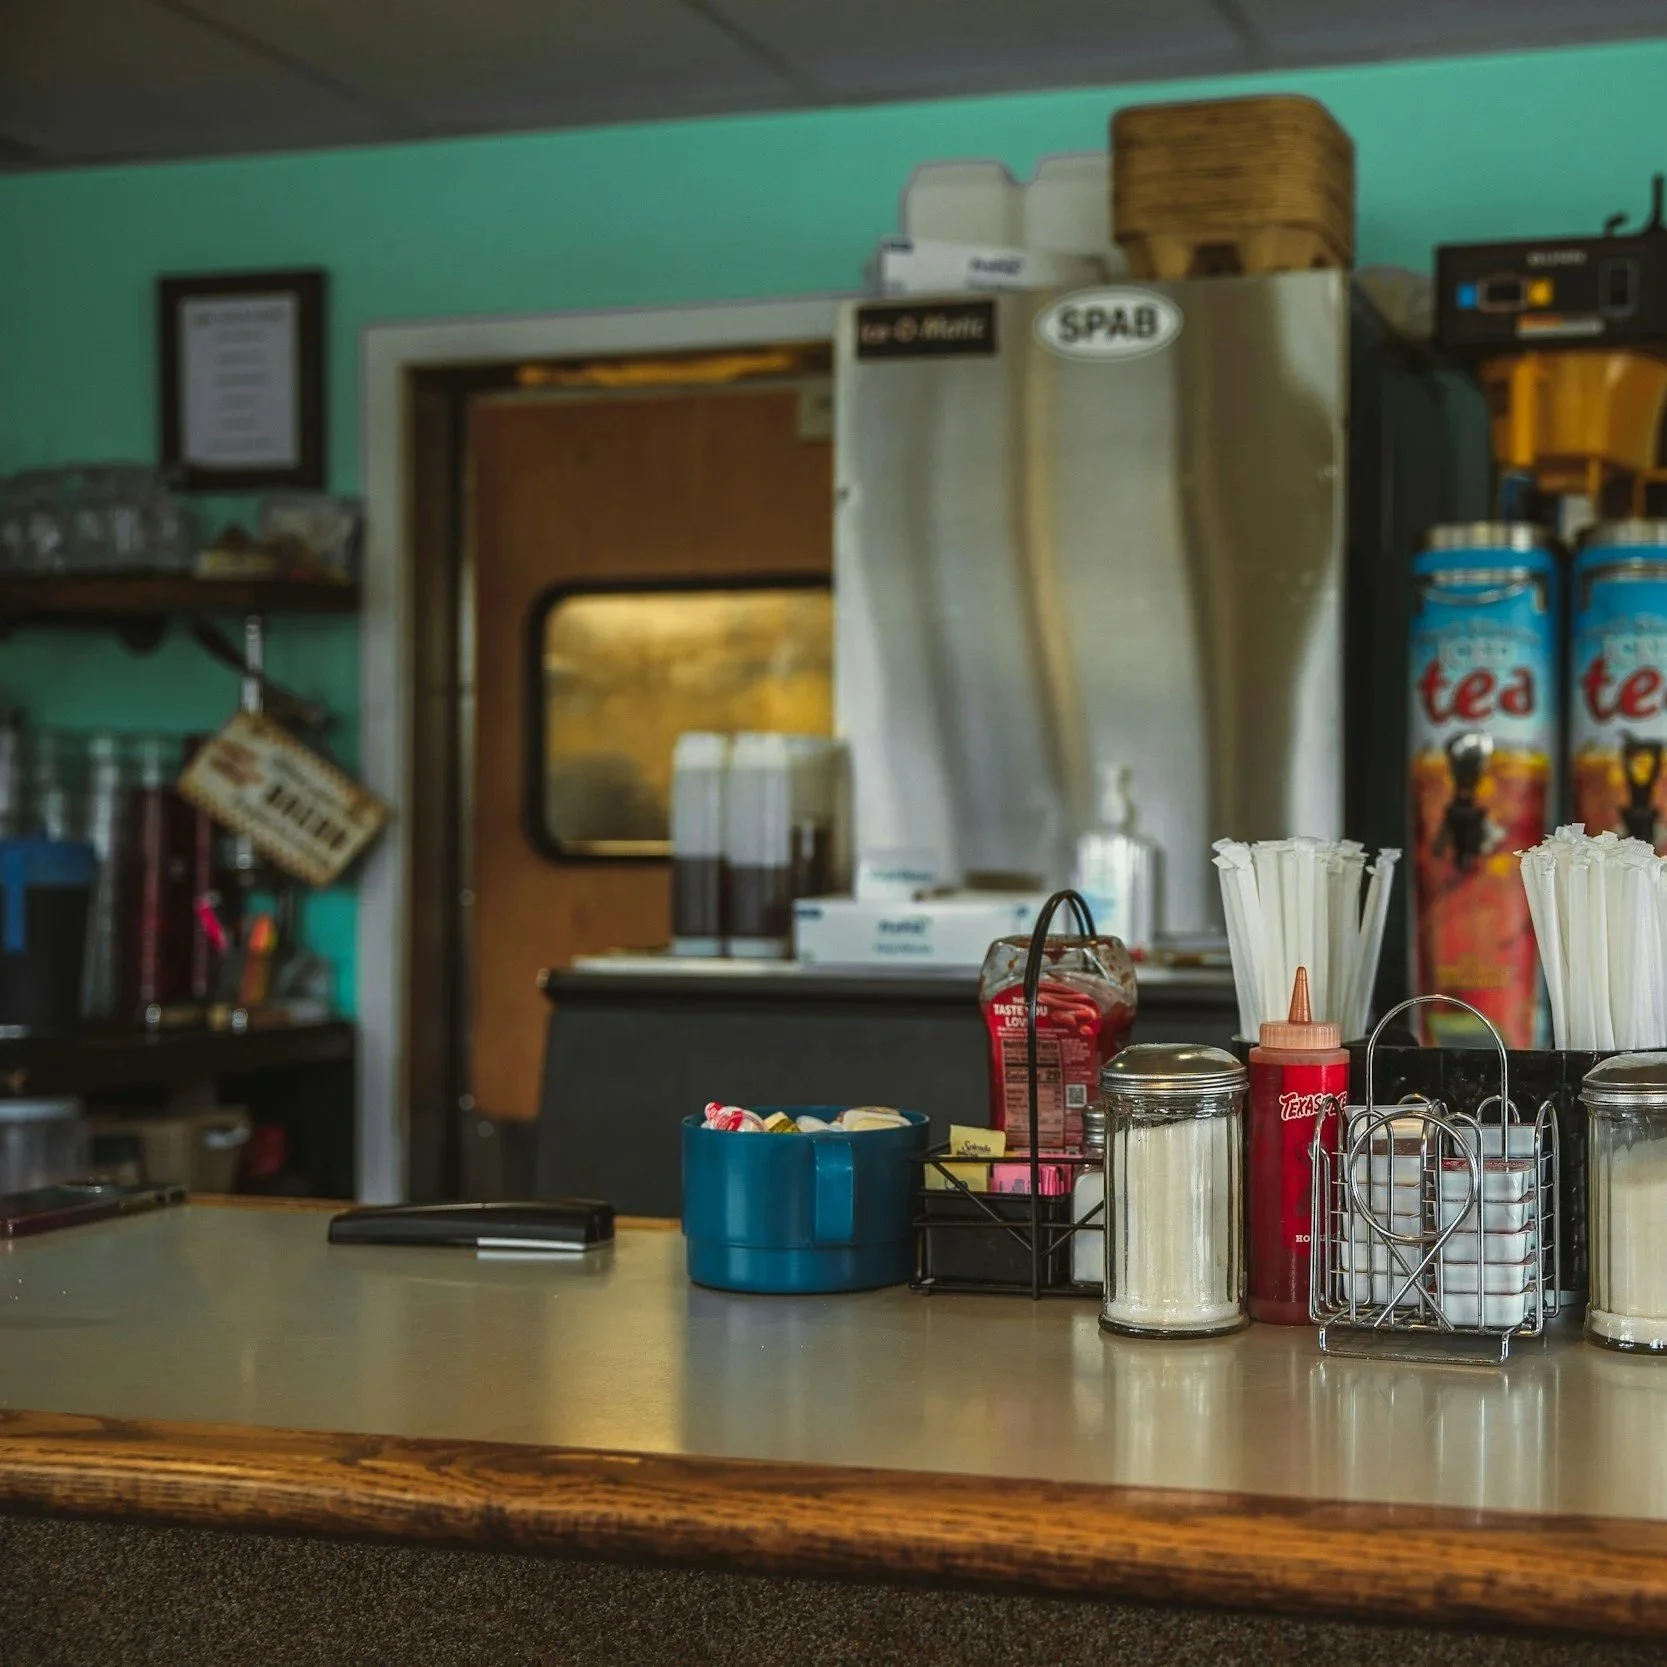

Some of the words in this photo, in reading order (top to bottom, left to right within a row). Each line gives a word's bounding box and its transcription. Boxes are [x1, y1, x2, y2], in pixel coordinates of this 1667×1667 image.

[1058, 303, 1160, 343] SPAB
[1417, 657, 1535, 727] tea
[1583, 655, 1667, 725] te
[993, 1004, 1024, 1016] TASTE
[1005, 1017, 1029, 1027] LOV
[1279, 1092, 1323, 1121] TEXAS
[1295, 1234, 1311, 1243] HO
